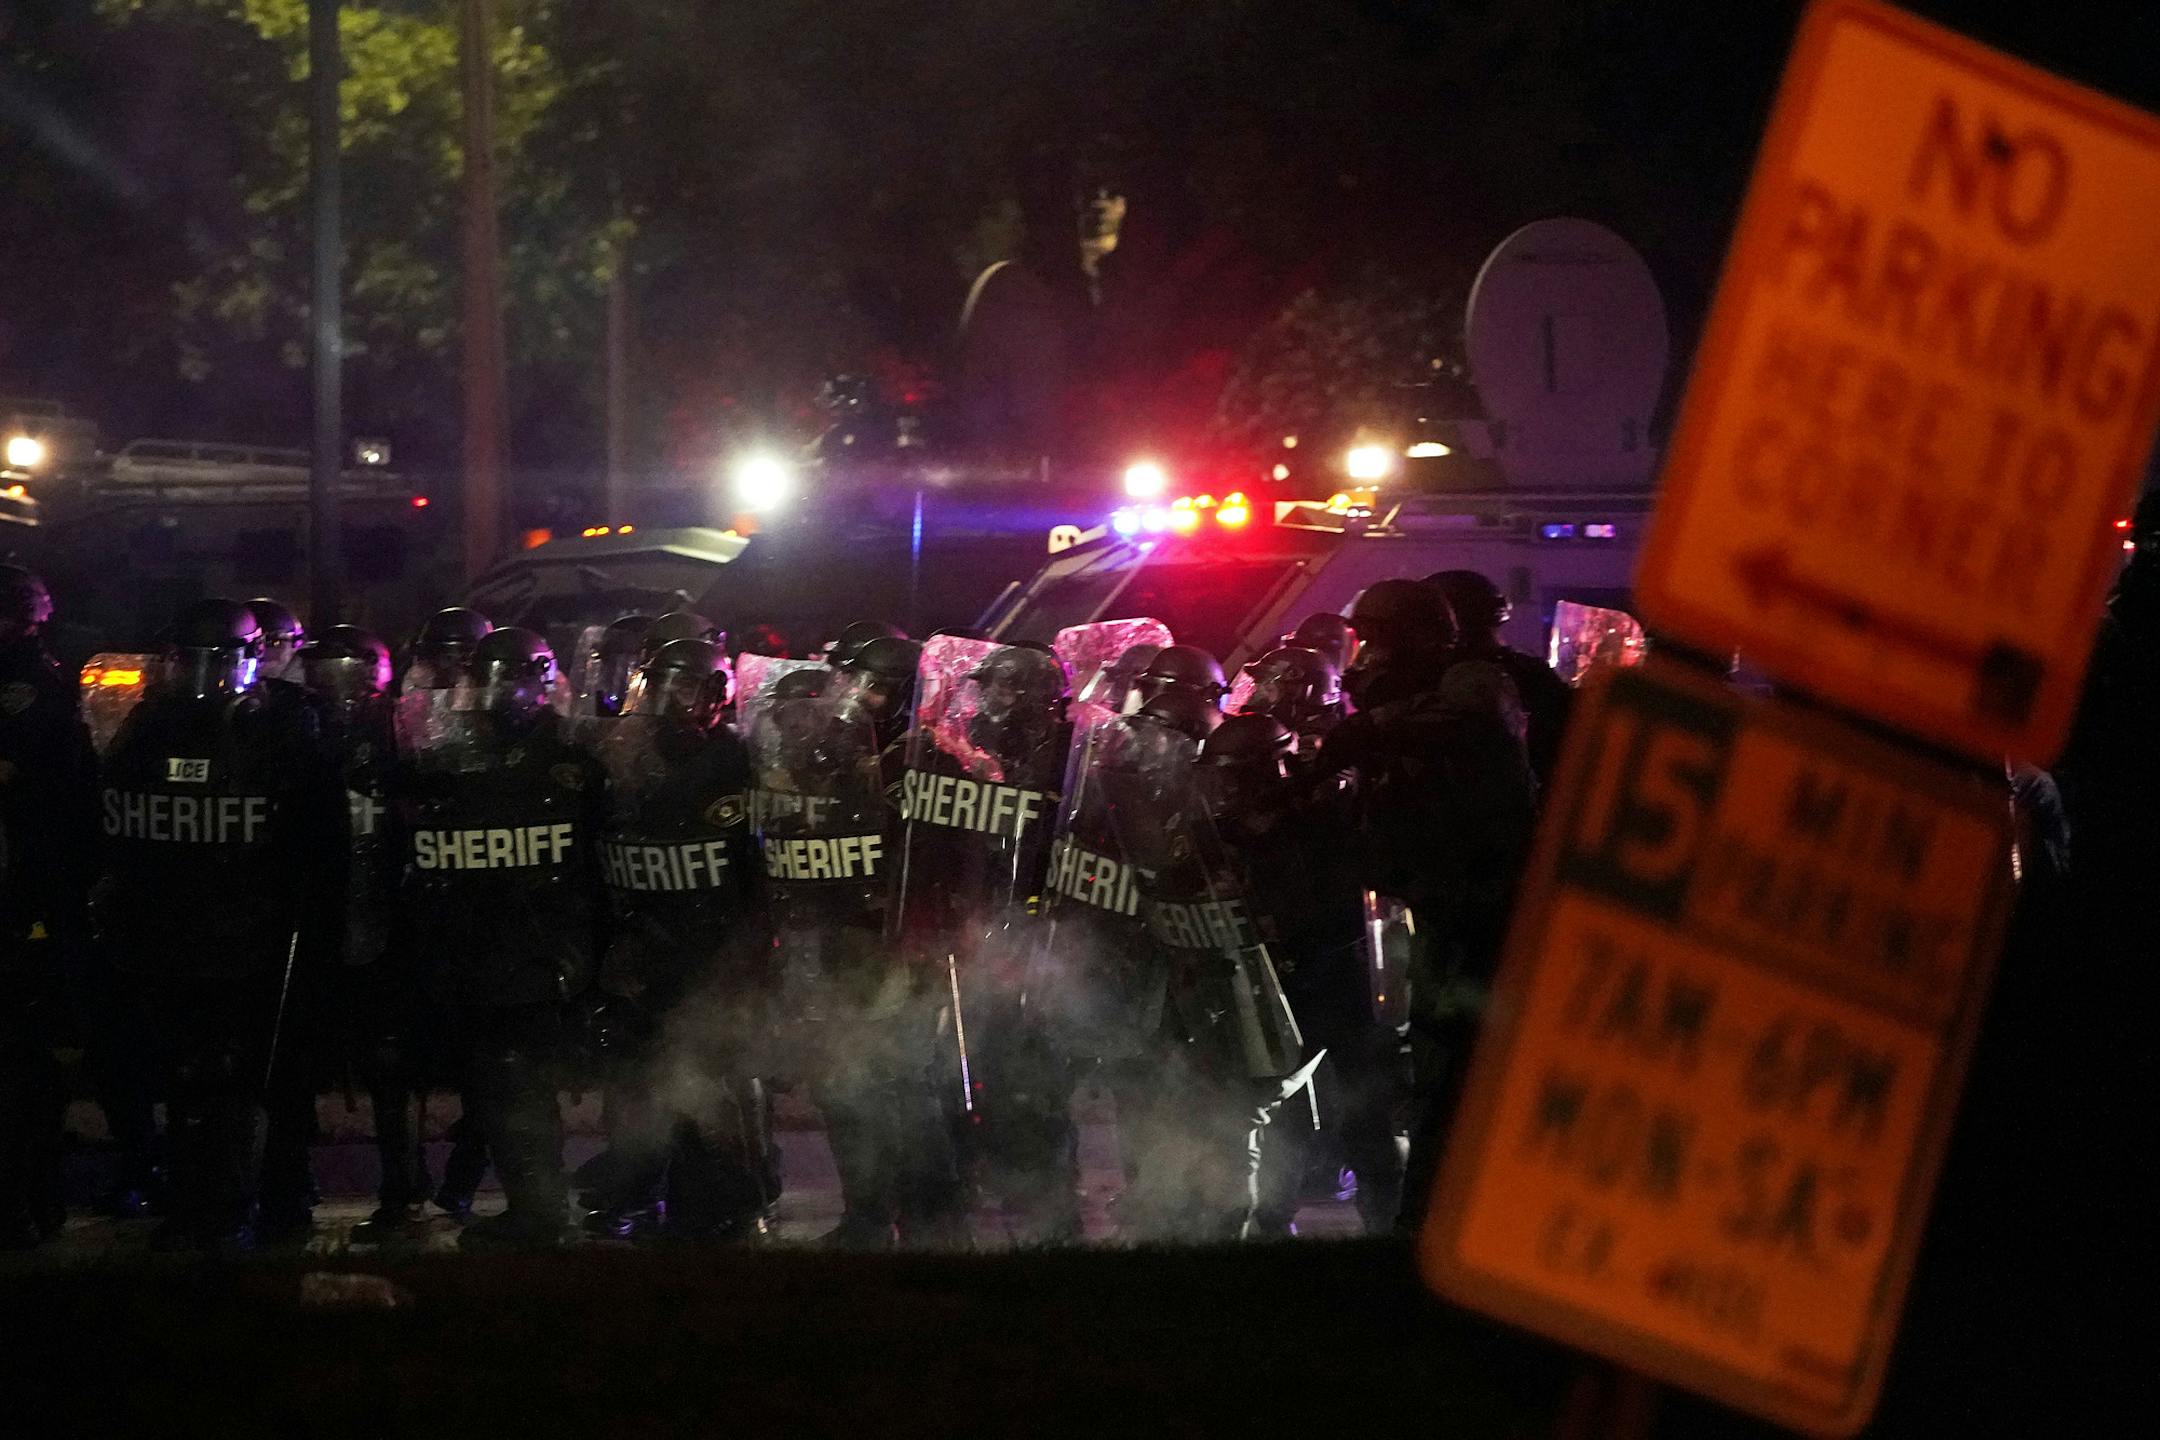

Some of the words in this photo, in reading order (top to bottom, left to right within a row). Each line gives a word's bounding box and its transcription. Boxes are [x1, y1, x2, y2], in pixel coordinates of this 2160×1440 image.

[1906, 90, 2074, 248] NO
[1762, 182, 2143, 421] PARKING
[102, 787, 267, 843] SHERIFF
[902, 768, 1043, 838] SHERIFF
[414, 823, 574, 869] SHERIFF
[764, 834, 883, 879] SHERIFF
